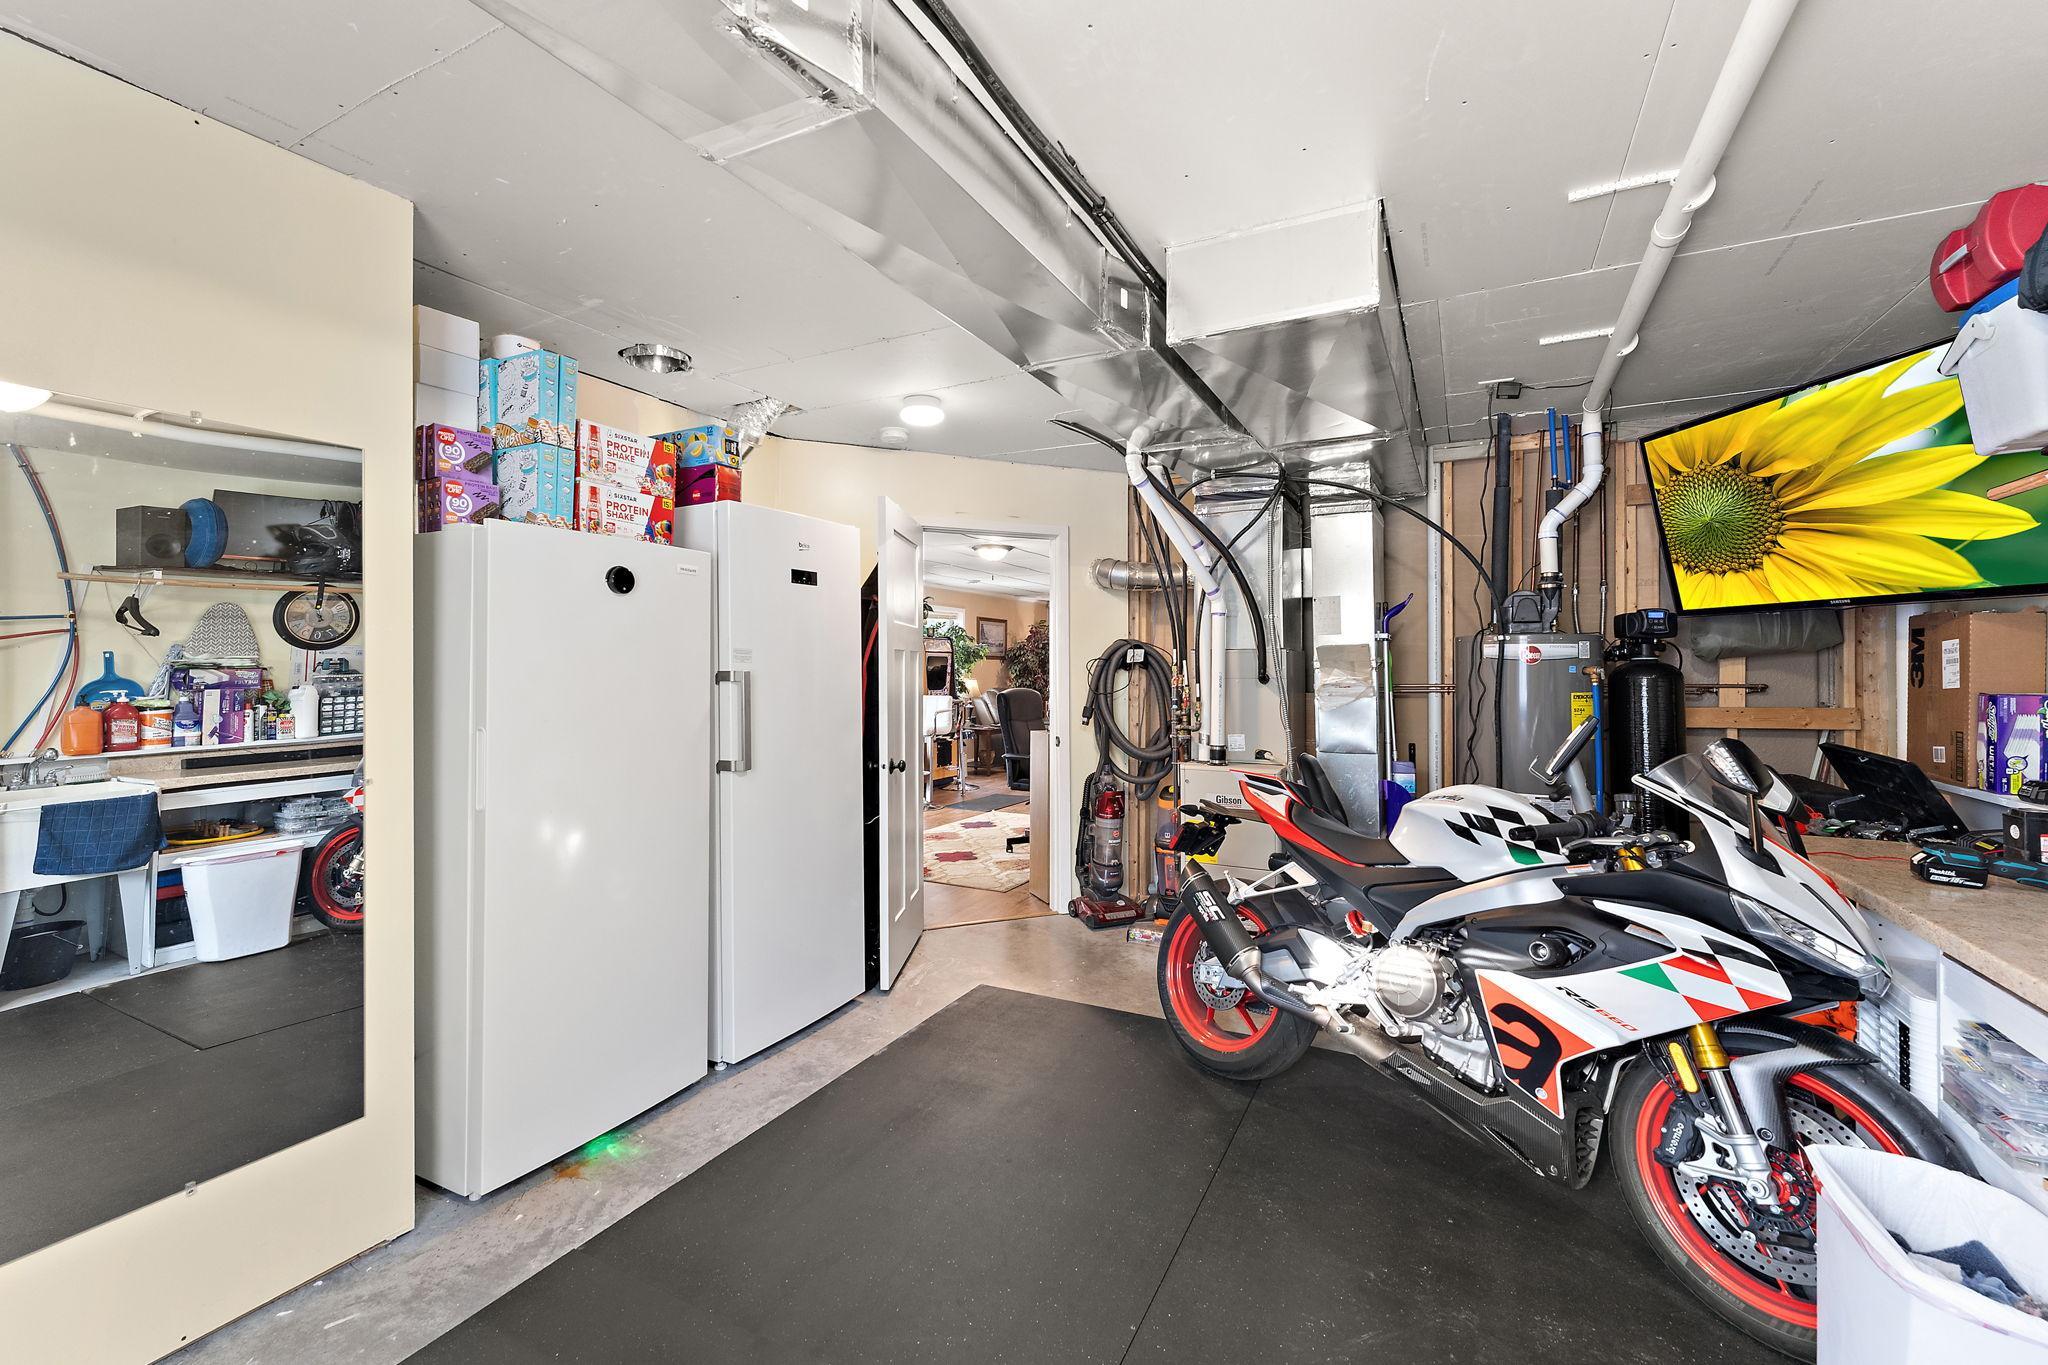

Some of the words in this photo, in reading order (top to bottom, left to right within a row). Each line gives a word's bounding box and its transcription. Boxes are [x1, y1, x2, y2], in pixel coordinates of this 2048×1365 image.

[444, 445, 460, 455] 90
[606, 440, 650, 459] PROTEIN
[607, 449, 636, 463] SHAKE
[451, 497, 468, 507] 90
[606, 500, 649, 517] PROTEIN
[606, 510, 635, 521] SHAKE
[1911, 628, 1925, 688] 3M
[1215, 794, 1242, 805] Gibson
[1665, 1122, 1685, 1156] brembo
